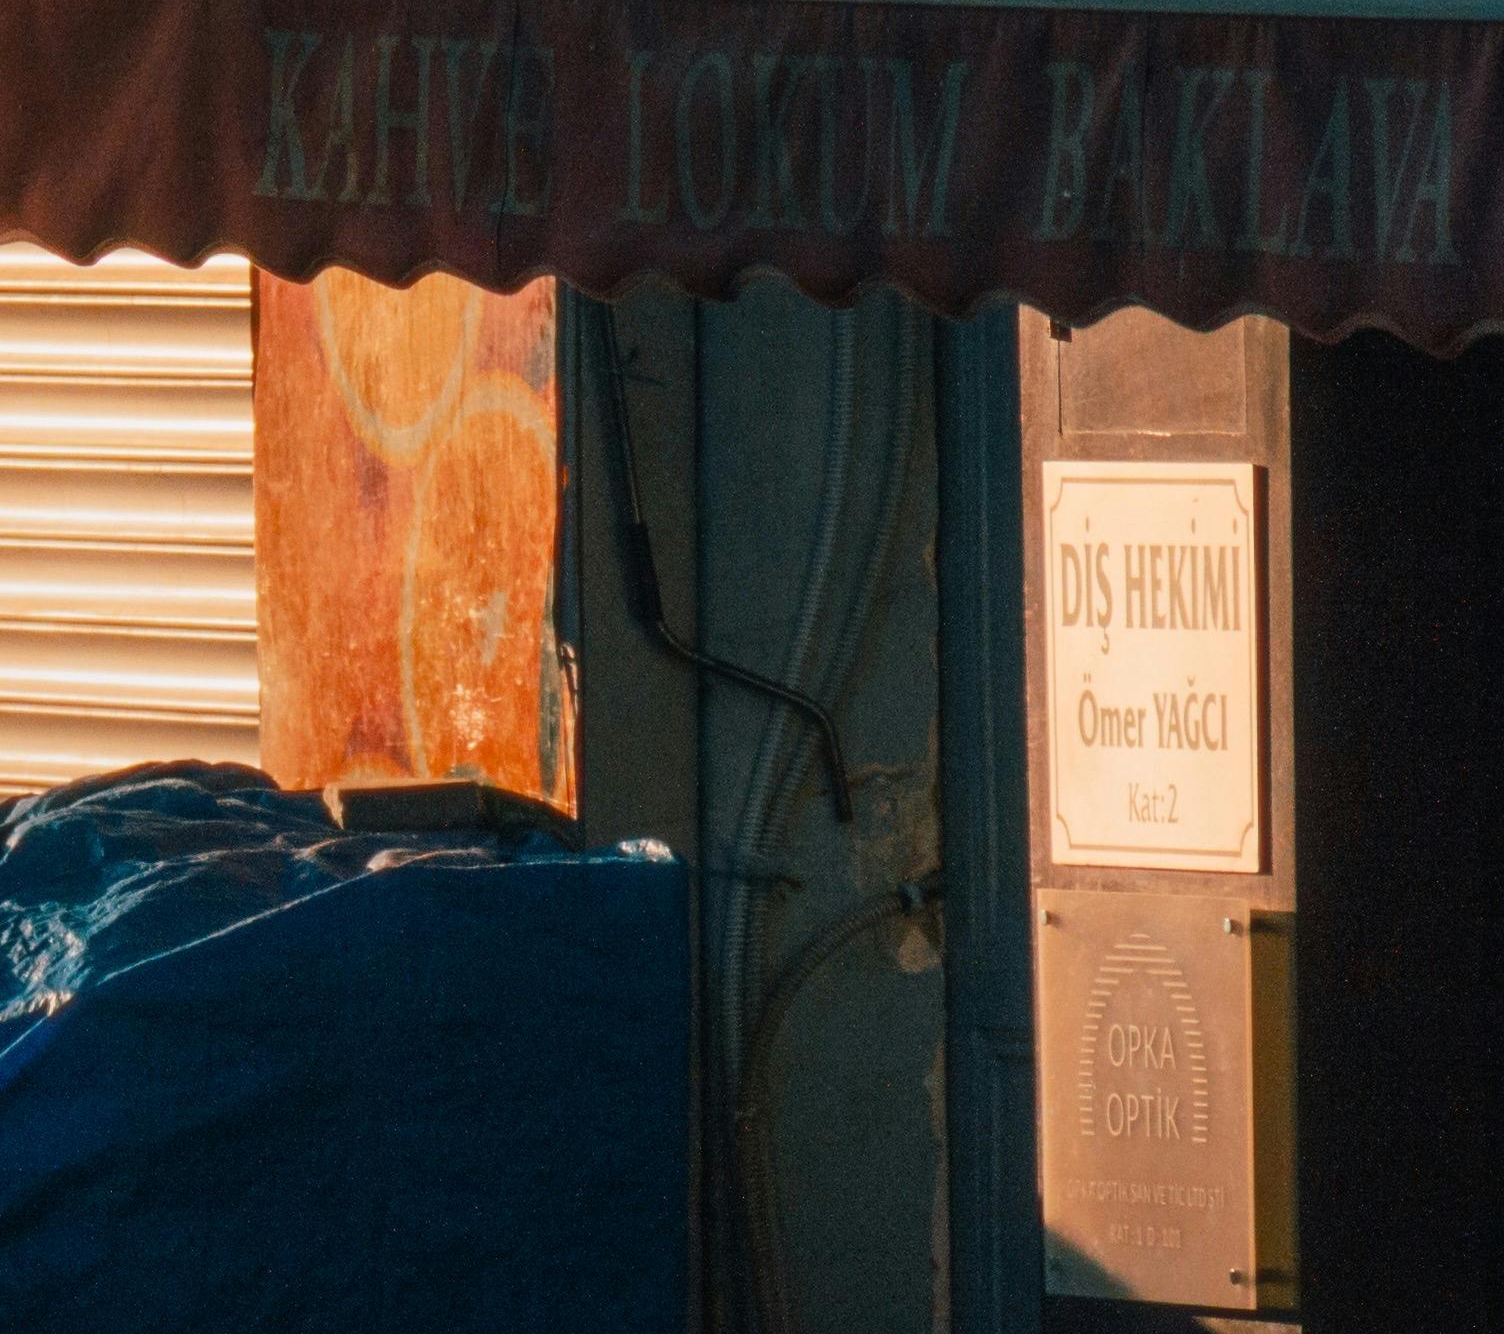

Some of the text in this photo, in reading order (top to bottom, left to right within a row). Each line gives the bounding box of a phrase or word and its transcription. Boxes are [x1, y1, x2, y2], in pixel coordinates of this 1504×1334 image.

[252, 27, 556, 218] KAHVE
[622, 51, 971, 238] LOKUM
[1036, 59, 1460, 265] BAKLAVA
[1059, 517, 1243, 655] DİŞ HEKİMİ
[1077, 673, 1229, 751] Ömer YAĞCI
[1107, 1022, 1177, 1071] OPKA
[1104, 1085, 1182, 1141] OPTİK
